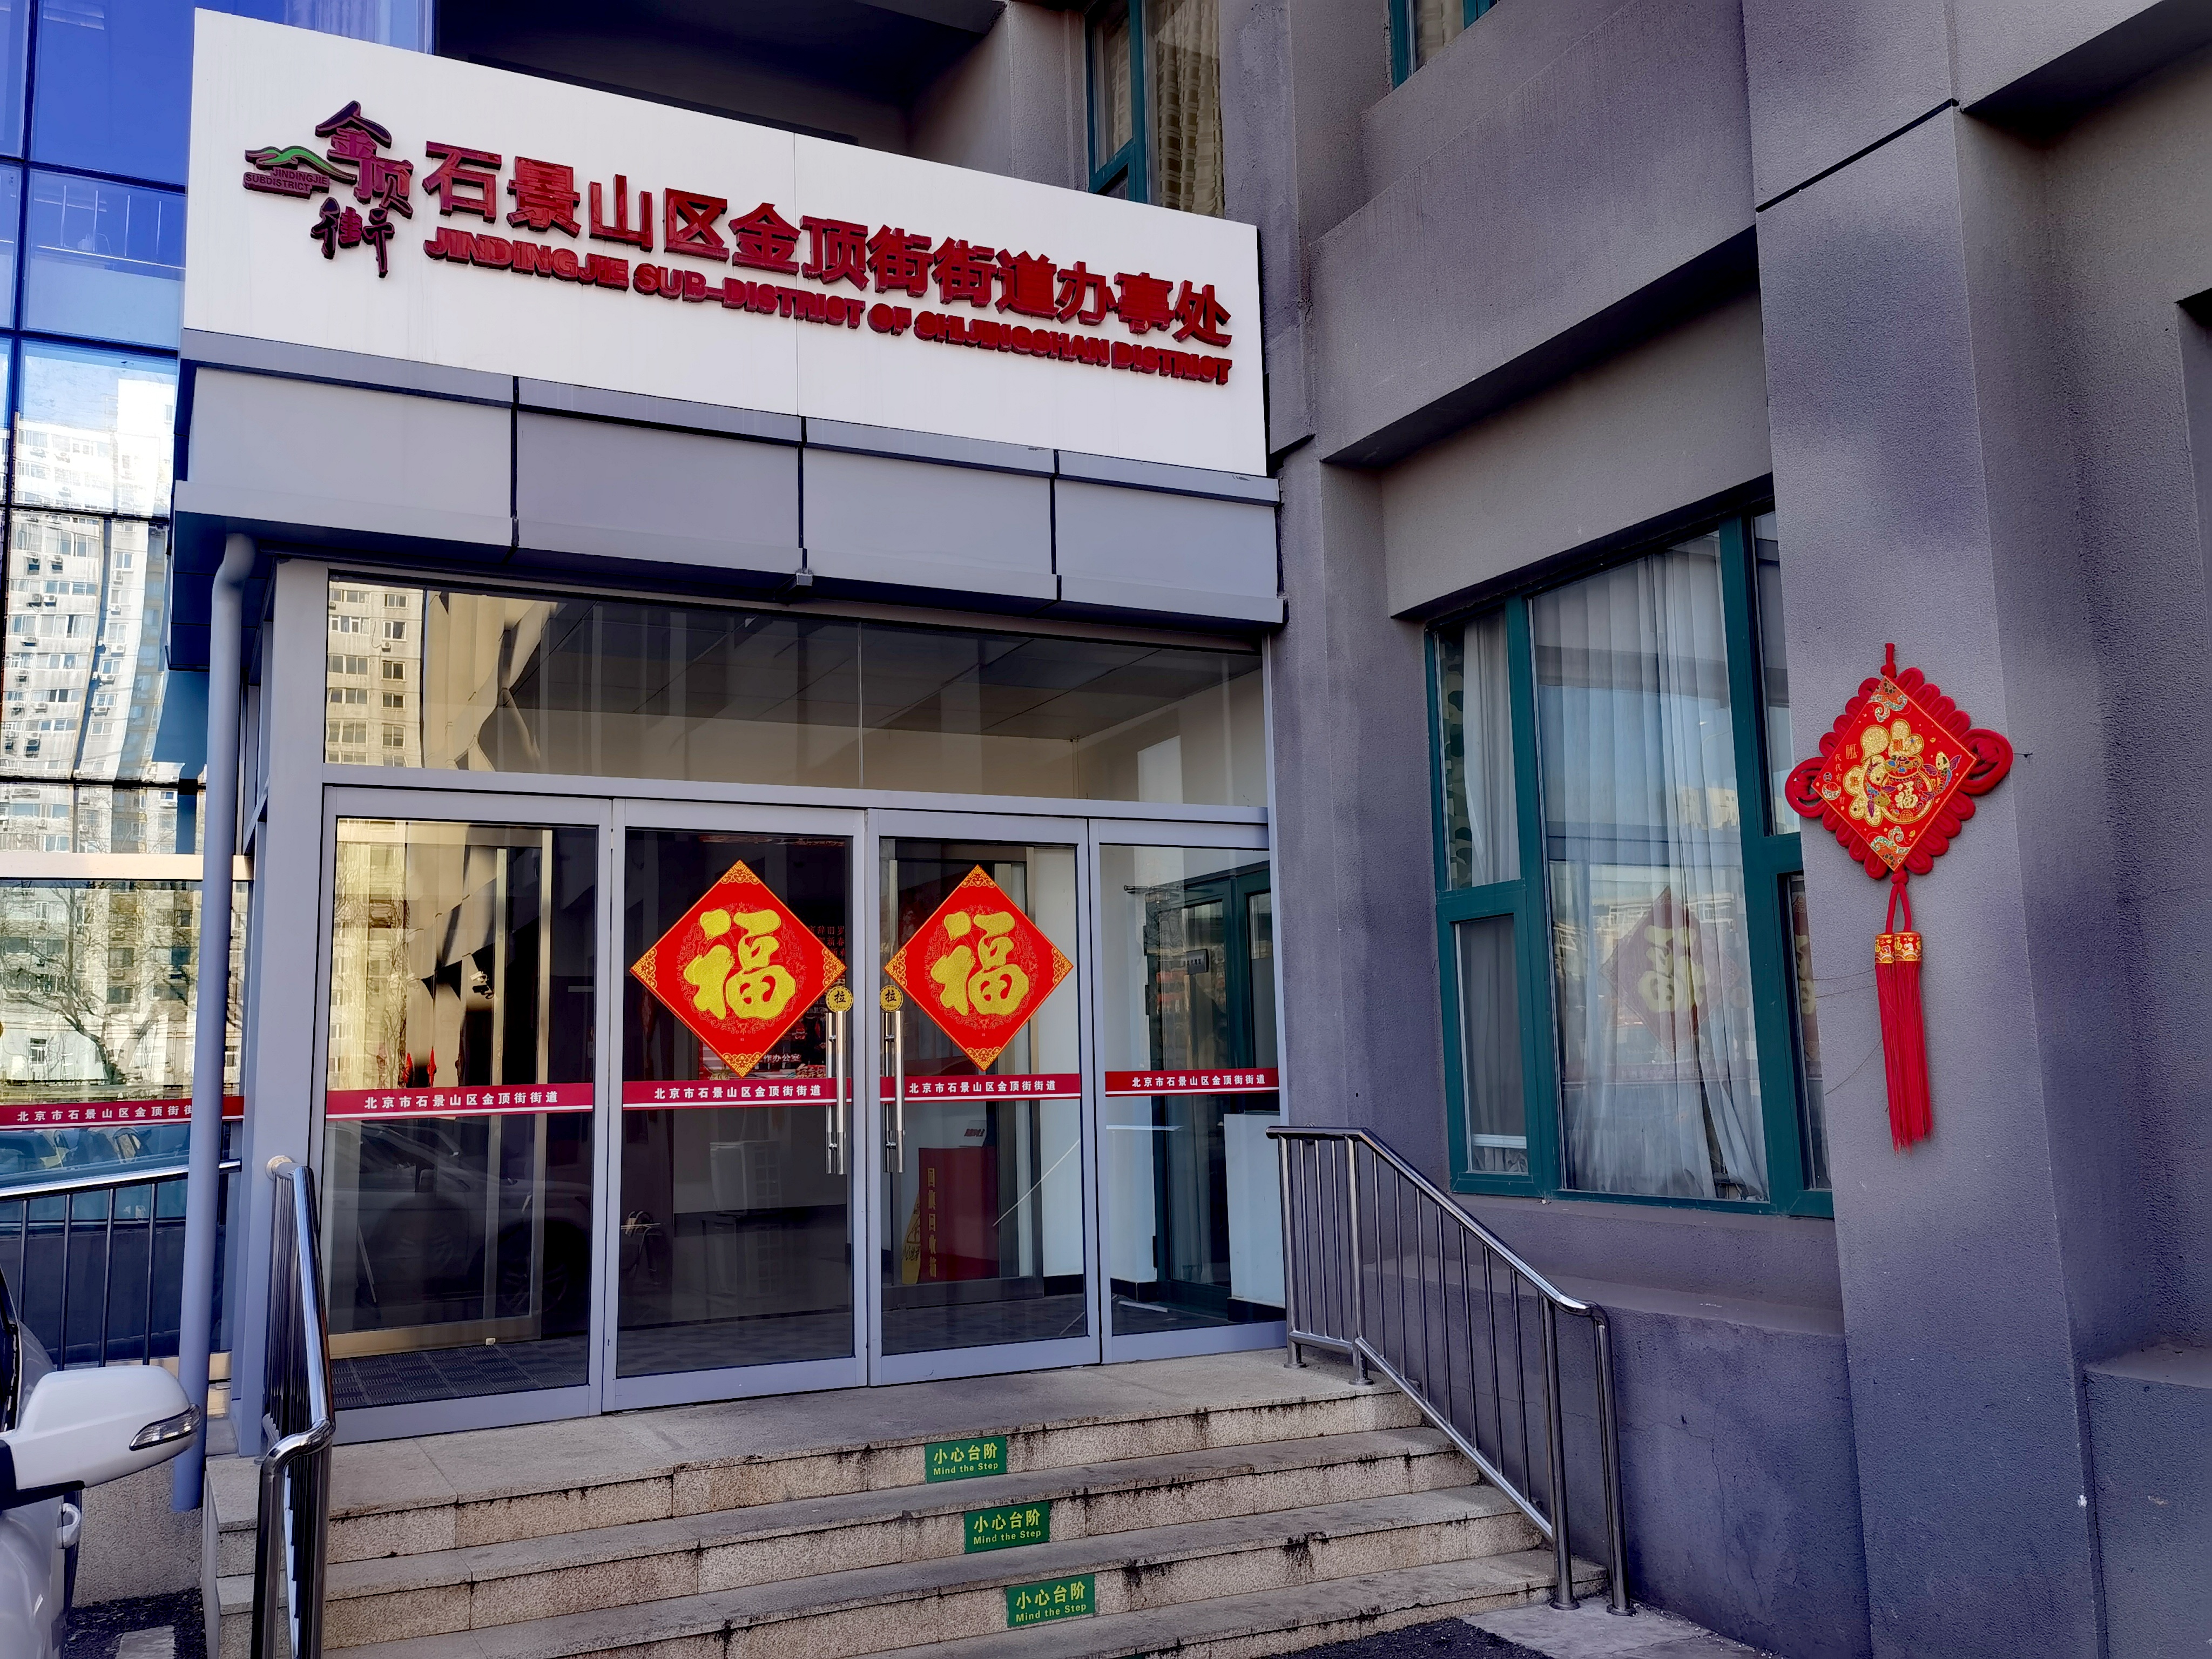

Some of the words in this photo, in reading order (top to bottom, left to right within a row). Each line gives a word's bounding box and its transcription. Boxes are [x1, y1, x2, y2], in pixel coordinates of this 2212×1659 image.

[245, 173, 311, 192] SUBDISTRICT
[272, 168, 328, 185] JINDINGJIE
[422, 141, 1232, 348] 石景山区金顶街街道办事处
[423, 226, 629, 291] JINDINGJIE
[633, 263, 865, 329] SUB-DISTRICT
[867, 303, 912, 336] OF
[1111, 341, 1232, 385] DISTRICT
[683, 908, 797, 1021] 福
[929, 911, 1030, 1016] 福
[833, 990, 846, 1003] 拉
[885, 989, 896, 1003] 拉
[759, 1054, 801, 1063] 作办公室
[909, 1081, 1056, 1094] 北京市石景山区金顶街街道
[1132, 1075, 1264, 1088] 北京市石景山区金顶街街道
[365, 1091, 558, 1109] 北京市石景山区金顶街街道
[655, 1084, 821, 1099] 北京市石景山区金顶街街道
[934, 1442, 997, 1465] 小心台阶
[934, 1466, 956, 1475] Mind
[978, 1462, 999, 1471] Step
[974, 1508, 1040, 1533] 小心台阶
[974, 1534, 997, 1545] Mind
[1001, 1533, 1016, 1541] the
[1020, 1530, 1041, 1538] Step
[1016, 1581, 1085, 1609] 小心台阶
[1016, 1610, 1040, 1622] Mind
[1044, 1608, 1060, 1617] the
[1064, 1604, 1087, 1613] Step
